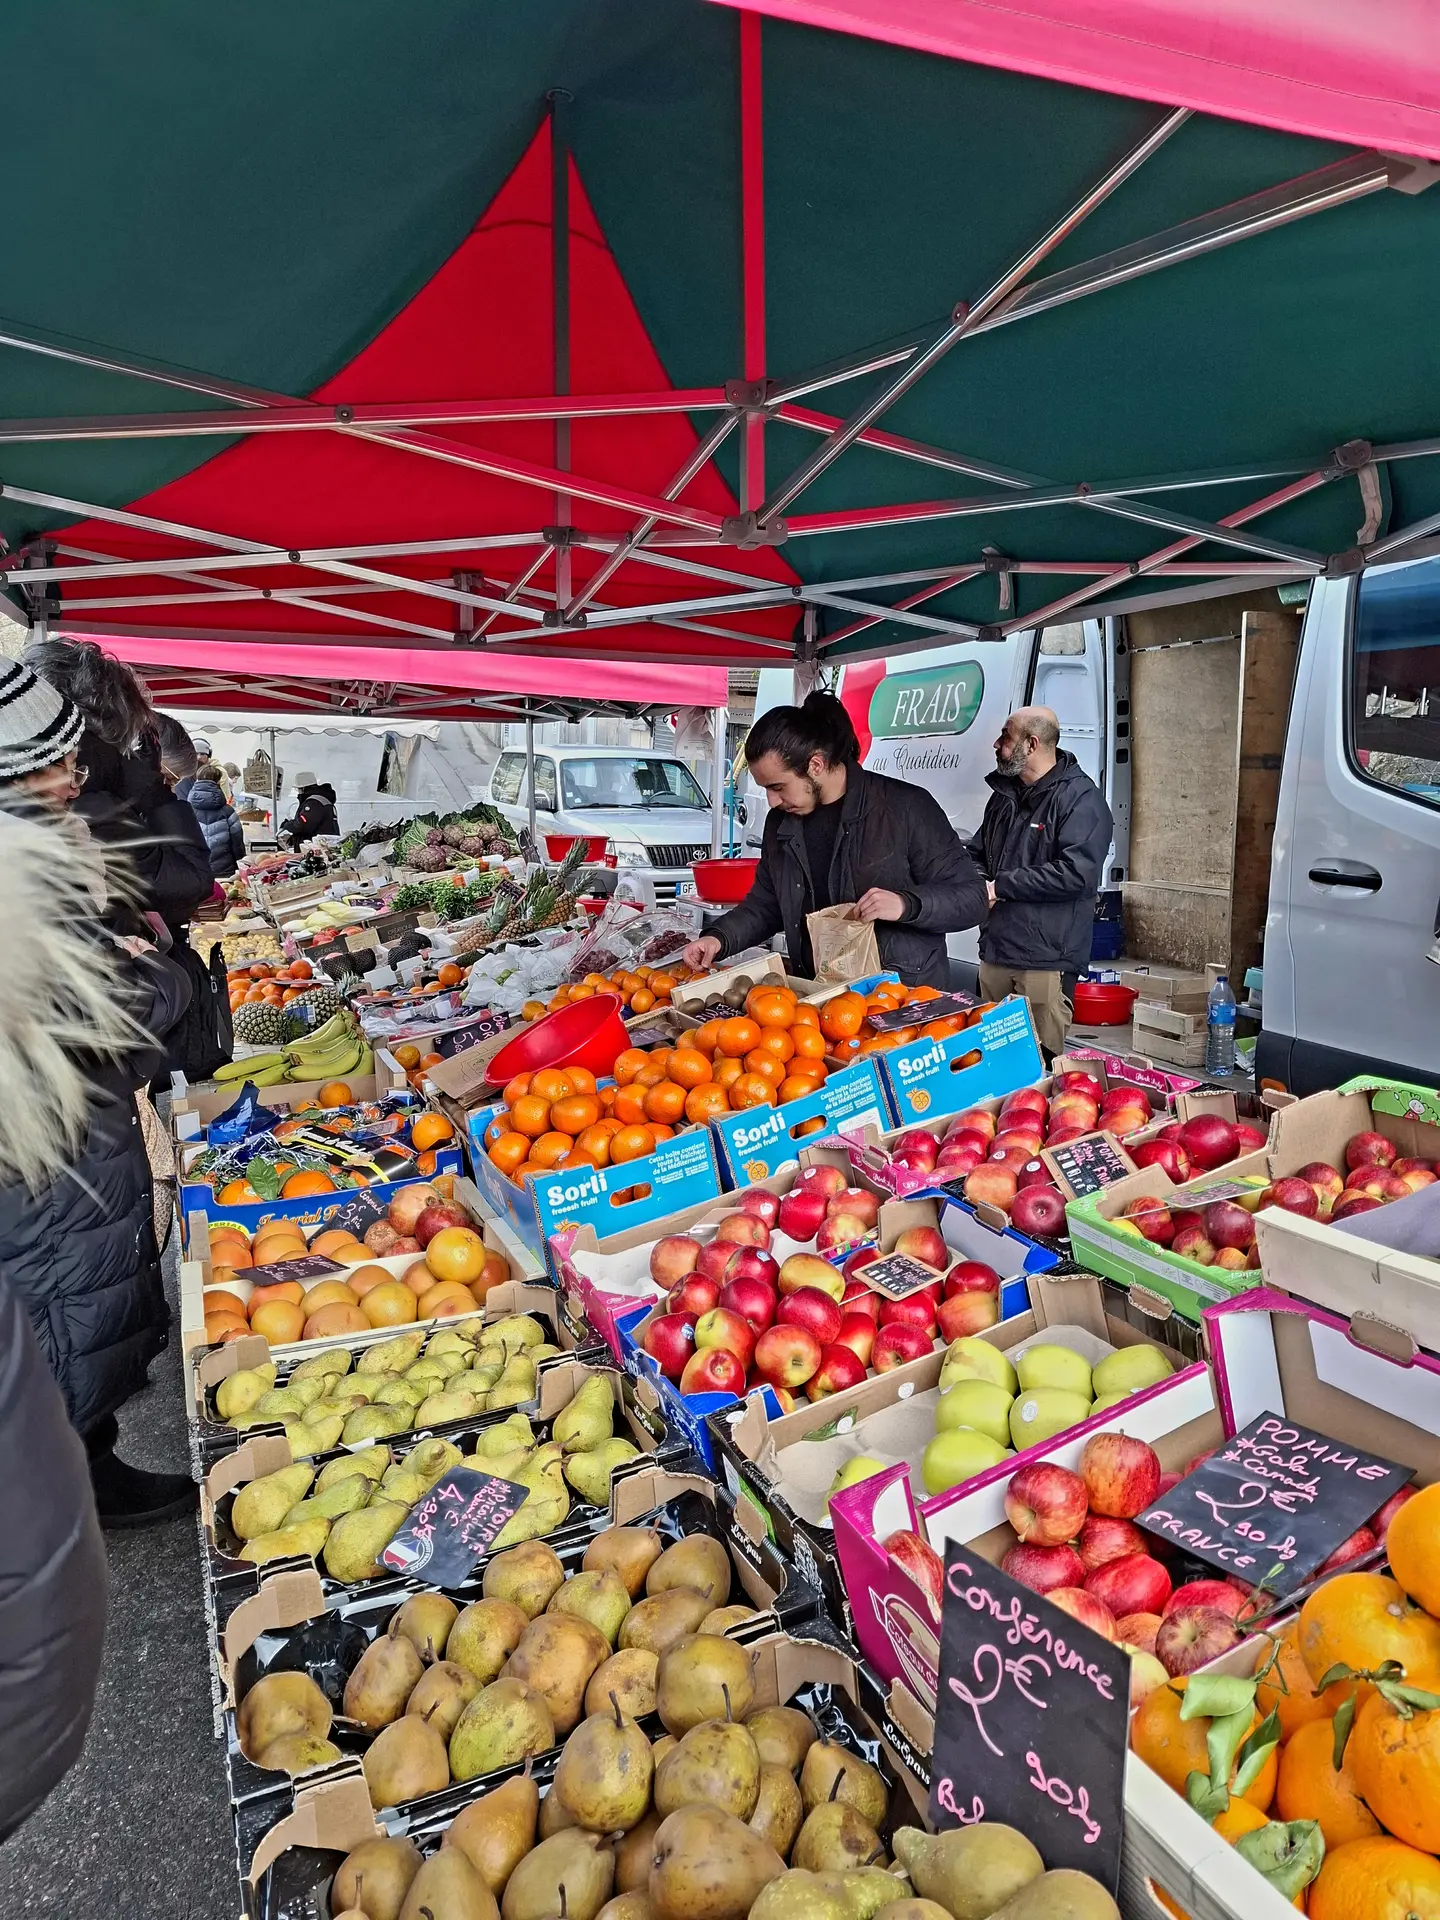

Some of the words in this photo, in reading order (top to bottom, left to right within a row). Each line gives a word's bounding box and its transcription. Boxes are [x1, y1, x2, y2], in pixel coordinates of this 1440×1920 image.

[890, 681, 966, 727] FRAIS
[872, 758, 888, 770] au
[893, 744, 962, 780] Quotidien
[898, 1044, 947, 1077] Sorli
[732, 1112, 787, 1148] Sorli
[648, 1154, 664, 1164] Cette
[1095, 1142, 1126, 1173] POMME
[547, 1172, 608, 1206] Sorli
[208, 1222, 242, 1230] PERIAL
[338, 1202, 356, 1220] 3
[1256, 1418, 1391, 1481] POMME
[1242, 1458, 1319, 1496] Canada
[469, 1506, 514, 1554] POIRE
[1145, 1510, 1256, 1568] FRANCE
[946, 1562, 1114, 1700] Conférence
